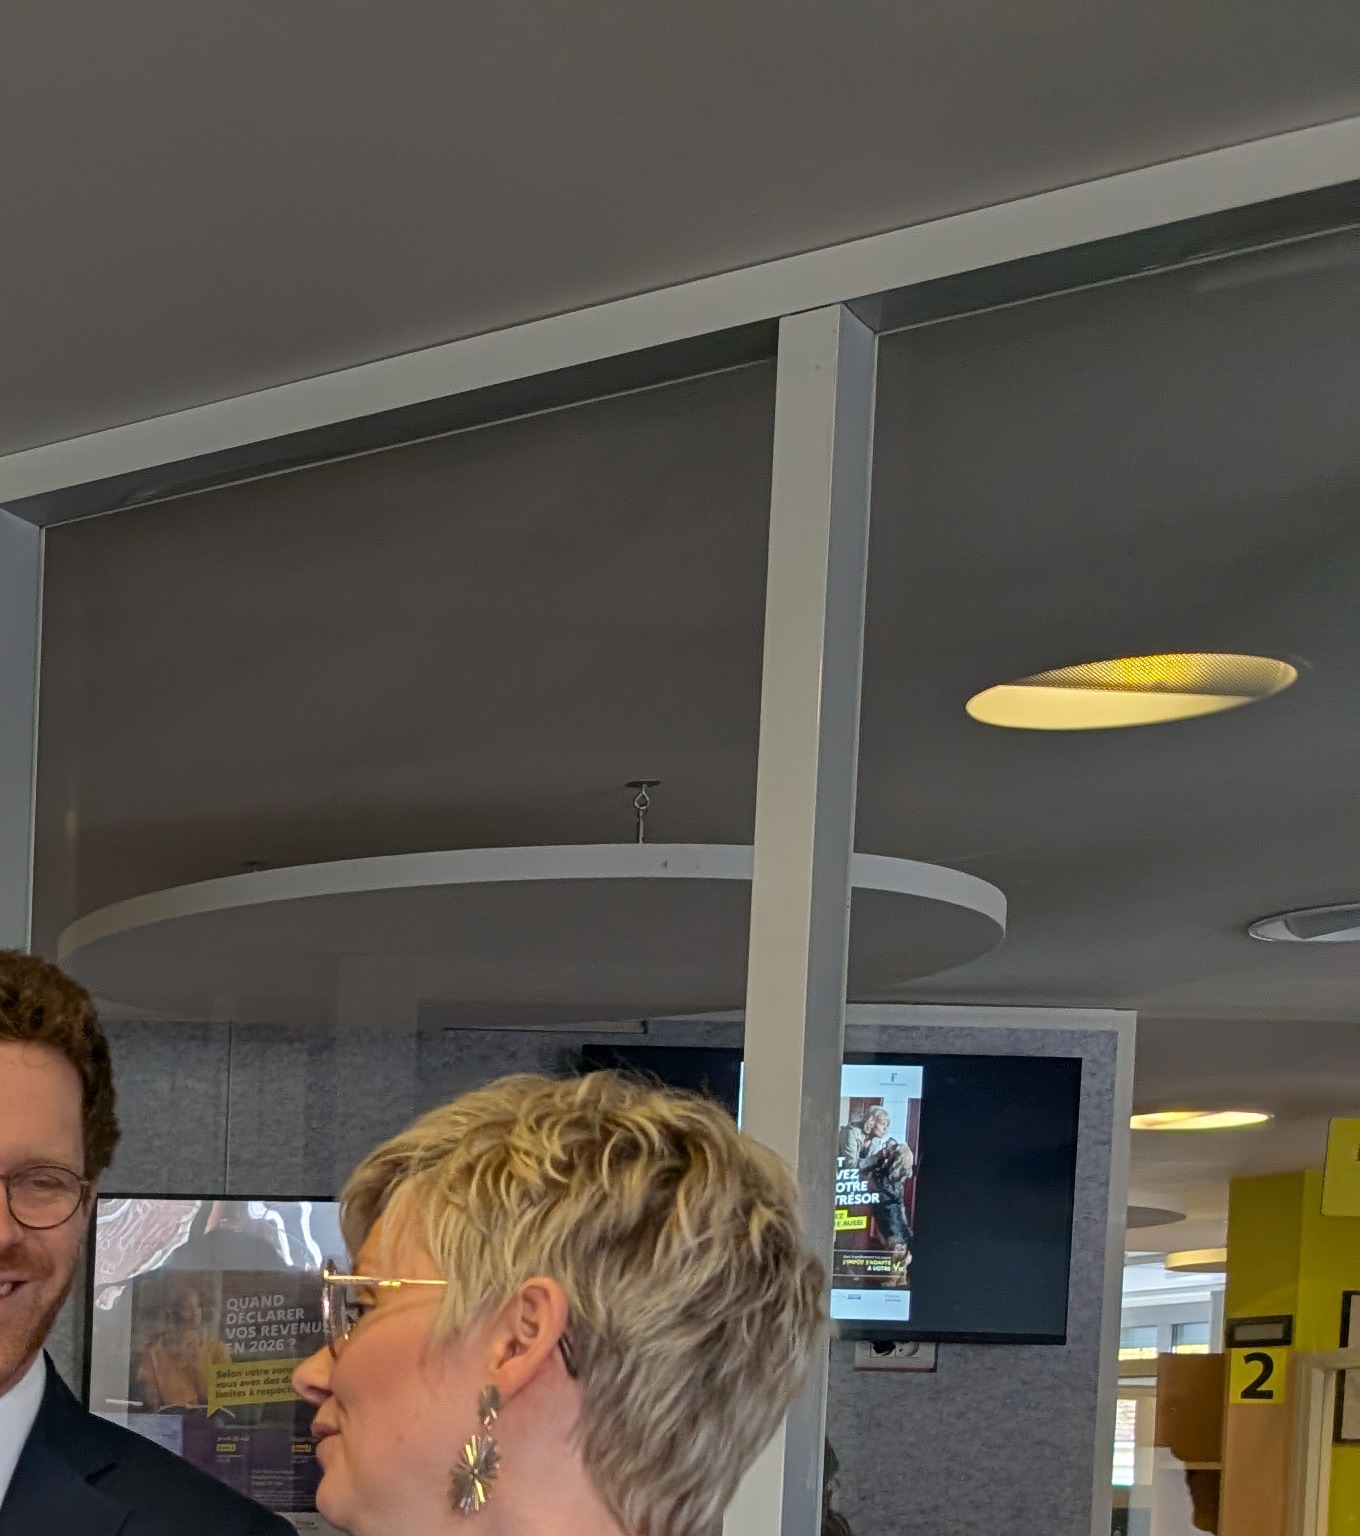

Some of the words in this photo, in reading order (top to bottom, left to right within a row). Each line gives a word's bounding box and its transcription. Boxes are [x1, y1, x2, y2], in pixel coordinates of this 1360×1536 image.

[835, 1180, 869, 1193] OTRE
[226, 1294, 285, 1311] QUAND
[226, 1306, 305, 1325] DÉCLARER
[225, 1325, 258, 1340] VOS
[224, 1341, 246, 1355] EN
[248, 1337, 286, 1353] 2026
[289, 1337, 297, 1350] ?
[215, 1369, 242, 1379] Selon
[1240, 1351, 1275, 1400] 2
